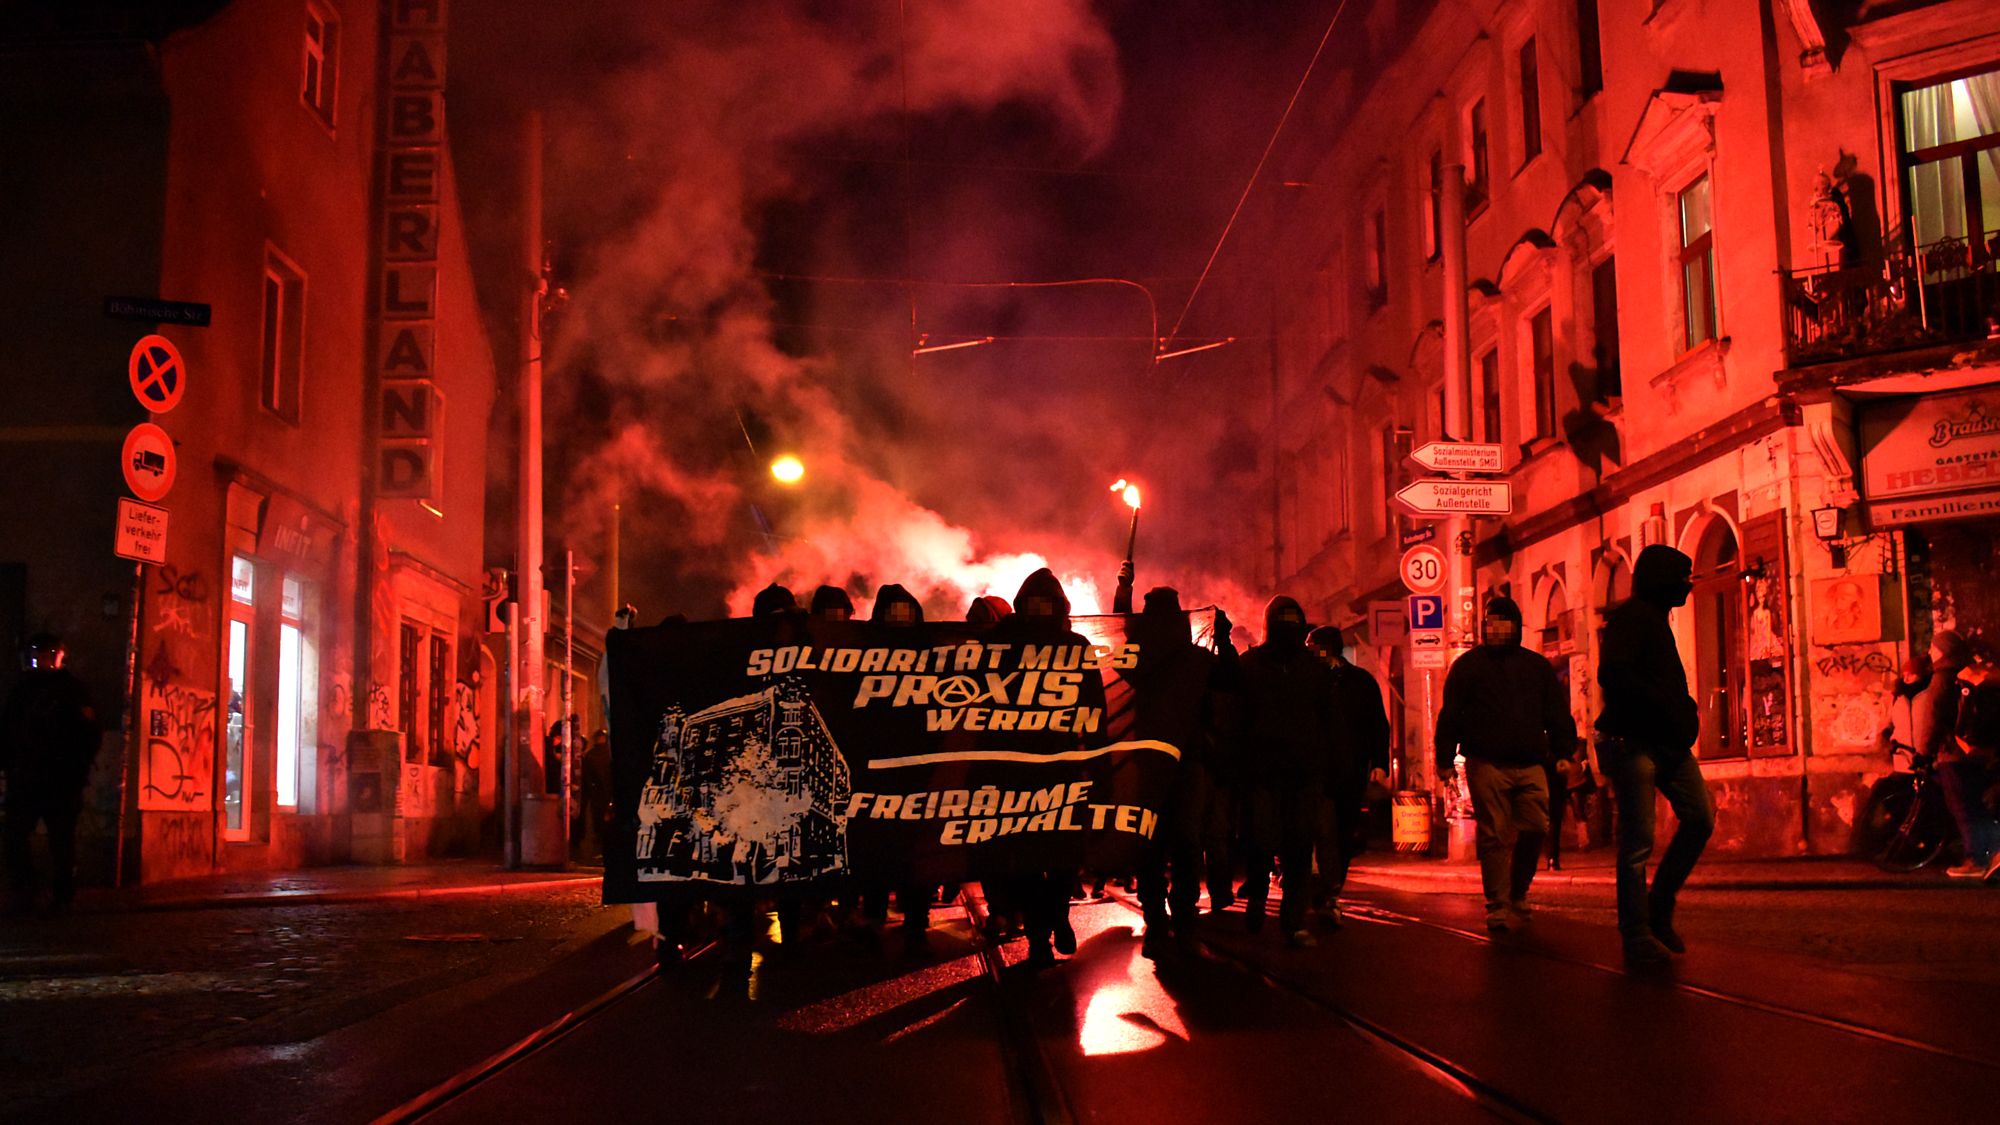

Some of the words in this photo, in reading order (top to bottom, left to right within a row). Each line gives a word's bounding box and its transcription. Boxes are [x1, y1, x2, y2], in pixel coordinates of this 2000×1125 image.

[1433, 446, 1497, 457] Sozialministerium
[1433, 457, 1476, 467] Außenstelle
[1433, 485, 1492, 498] Sozialgericht
[1436, 498, 1490, 509] Außenstelle
[128, 507, 161, 525] Liefer-
[125, 525, 162, 541] verkehr
[134, 540, 153, 555] frei
[1411, 559, 1438, 581] 30
[1417, 599, 1436, 626] P
[747, 640, 1011, 676] SOLIDARITÄT
[1018, 643, 1141, 672] MUSS
[853, 671, 1084, 709] PRAXIS
[926, 706, 1103, 734] WERDEN
[846, 780, 1094, 820] FREIRÄUME
